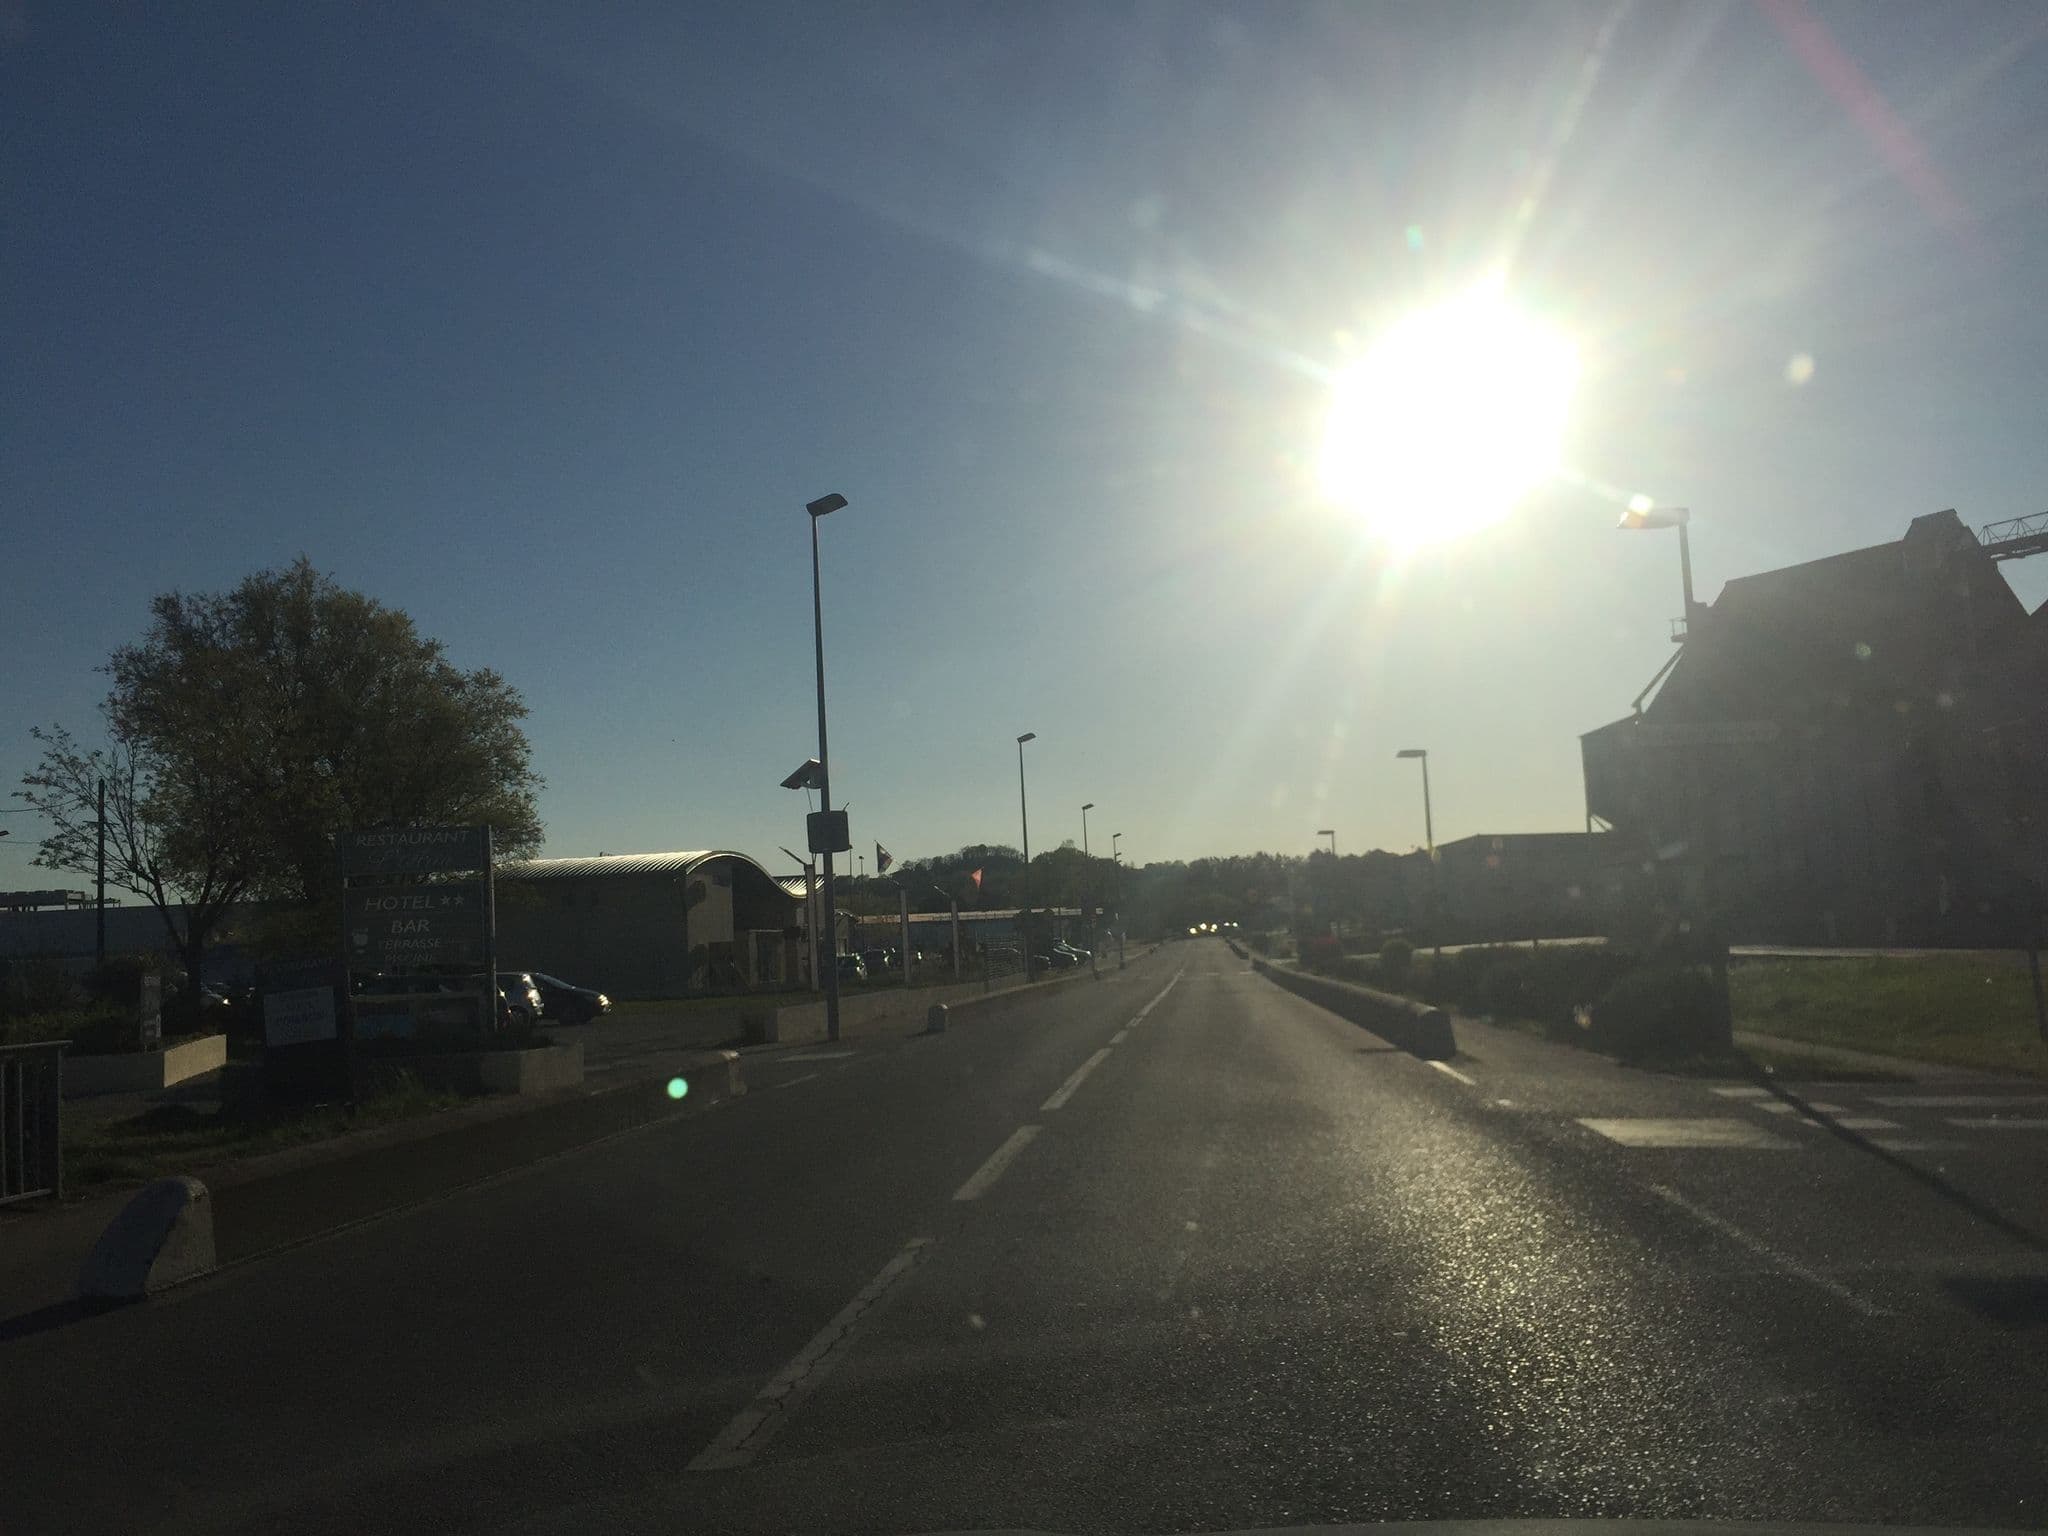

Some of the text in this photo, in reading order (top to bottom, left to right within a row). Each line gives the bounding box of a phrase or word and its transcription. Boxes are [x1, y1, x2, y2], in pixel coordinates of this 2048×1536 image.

[355, 830, 470, 847] RESTAURANT
[364, 896, 436, 911] HOTEL
[391, 919, 430, 933] BAR
